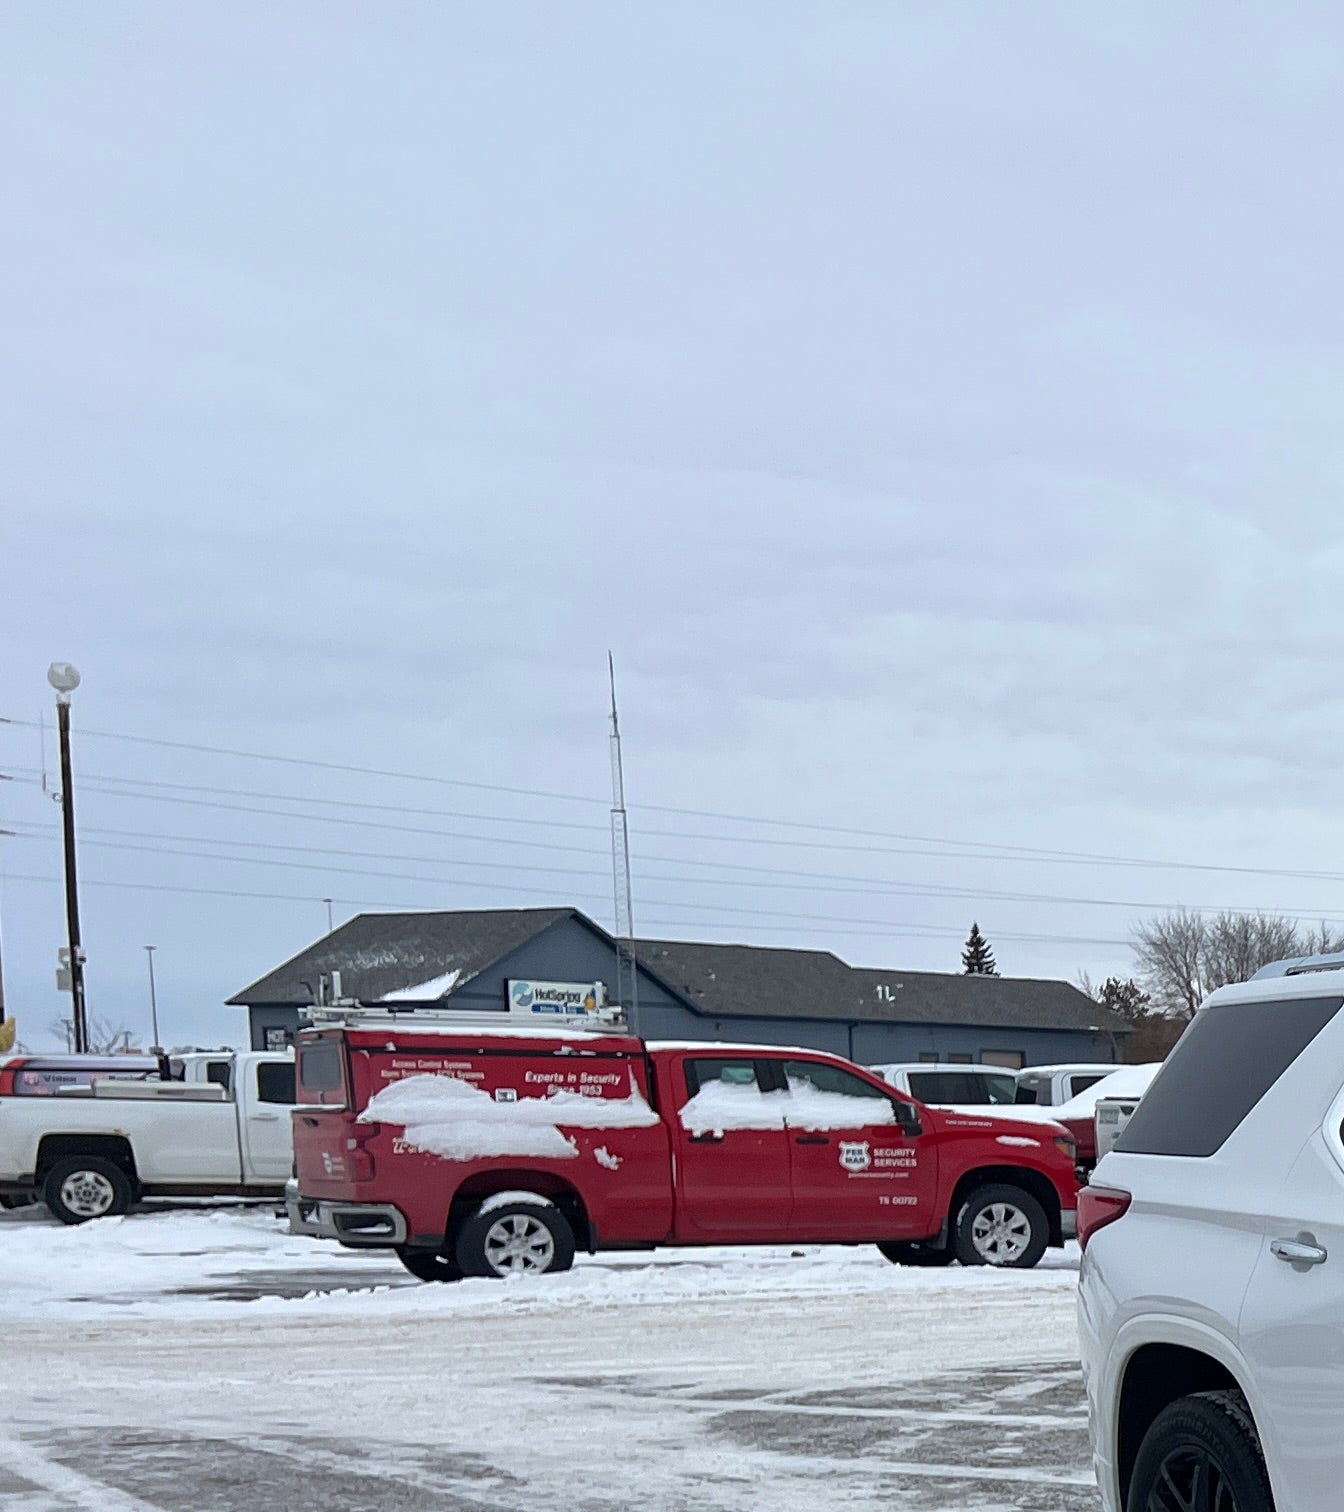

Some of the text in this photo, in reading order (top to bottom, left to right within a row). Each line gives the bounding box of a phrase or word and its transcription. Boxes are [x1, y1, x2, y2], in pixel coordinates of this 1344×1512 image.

[525, 1071, 621, 1085] Experts in Security
[873, 1148, 916, 1157] SECURITY
[874, 1158, 918, 1168] SERVICES
